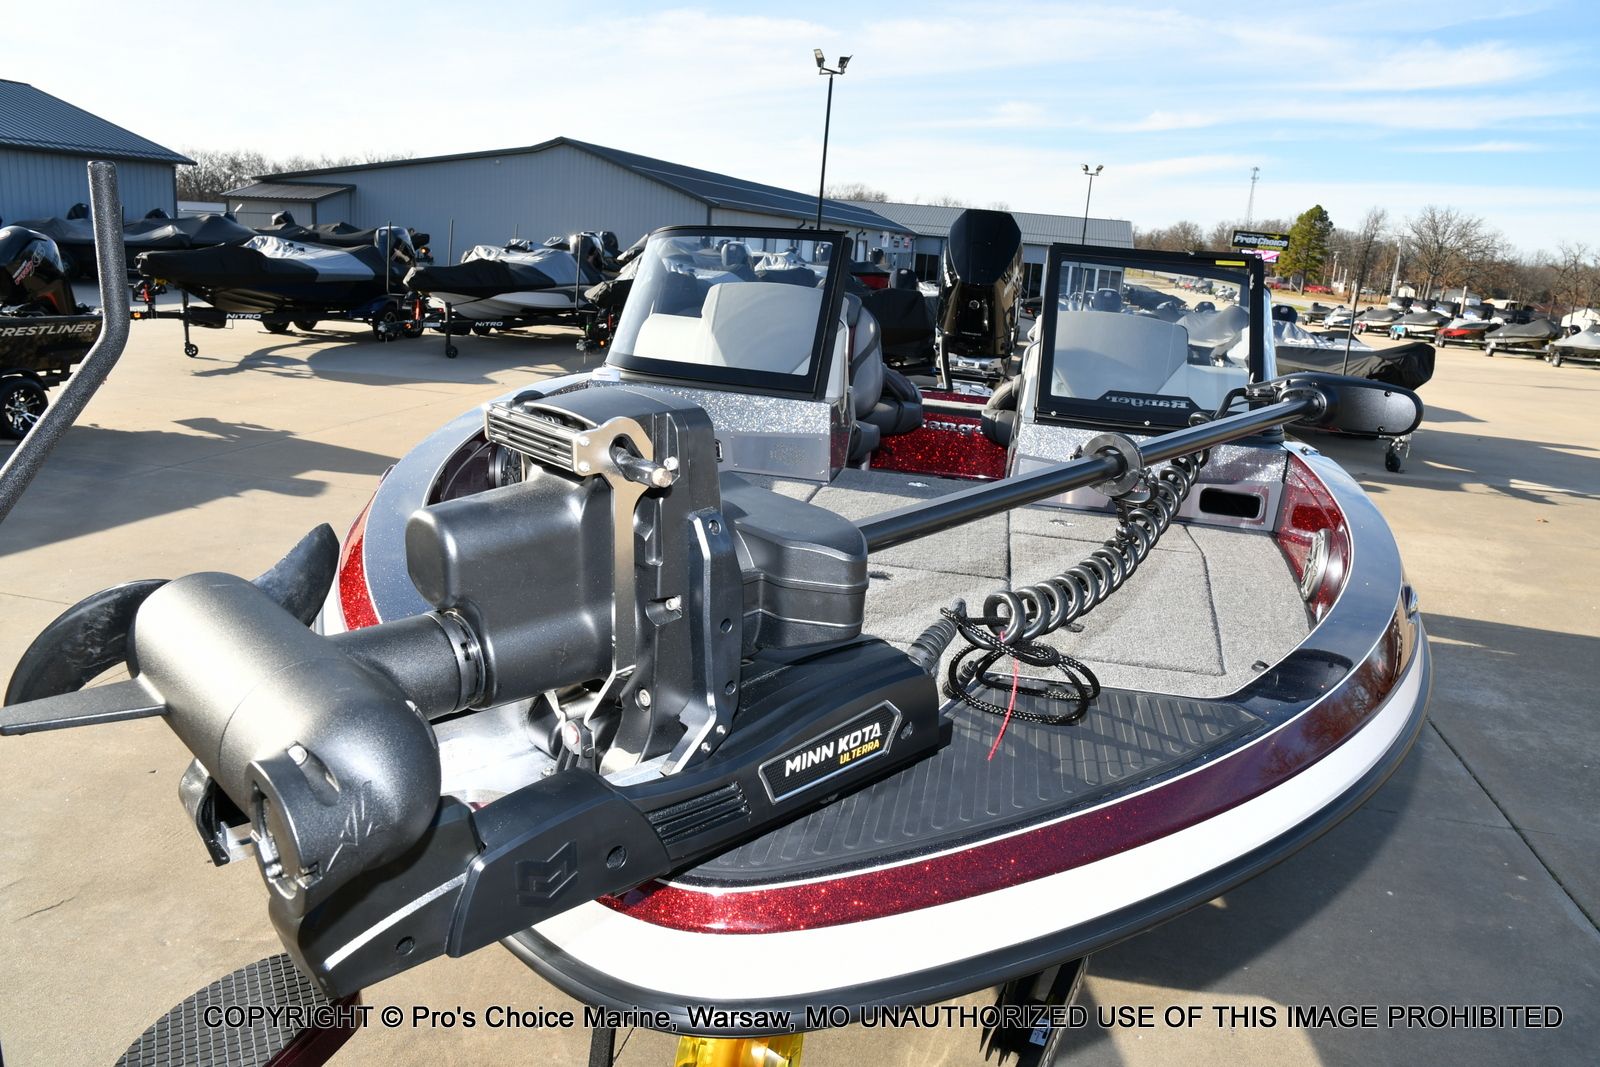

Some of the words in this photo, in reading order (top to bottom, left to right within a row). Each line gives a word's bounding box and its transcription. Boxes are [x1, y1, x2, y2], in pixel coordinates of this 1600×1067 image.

[785, 741, 835, 777] MINN
[837, 722, 883, 754] KOTA
[839, 739, 880, 764] ULTERRA
